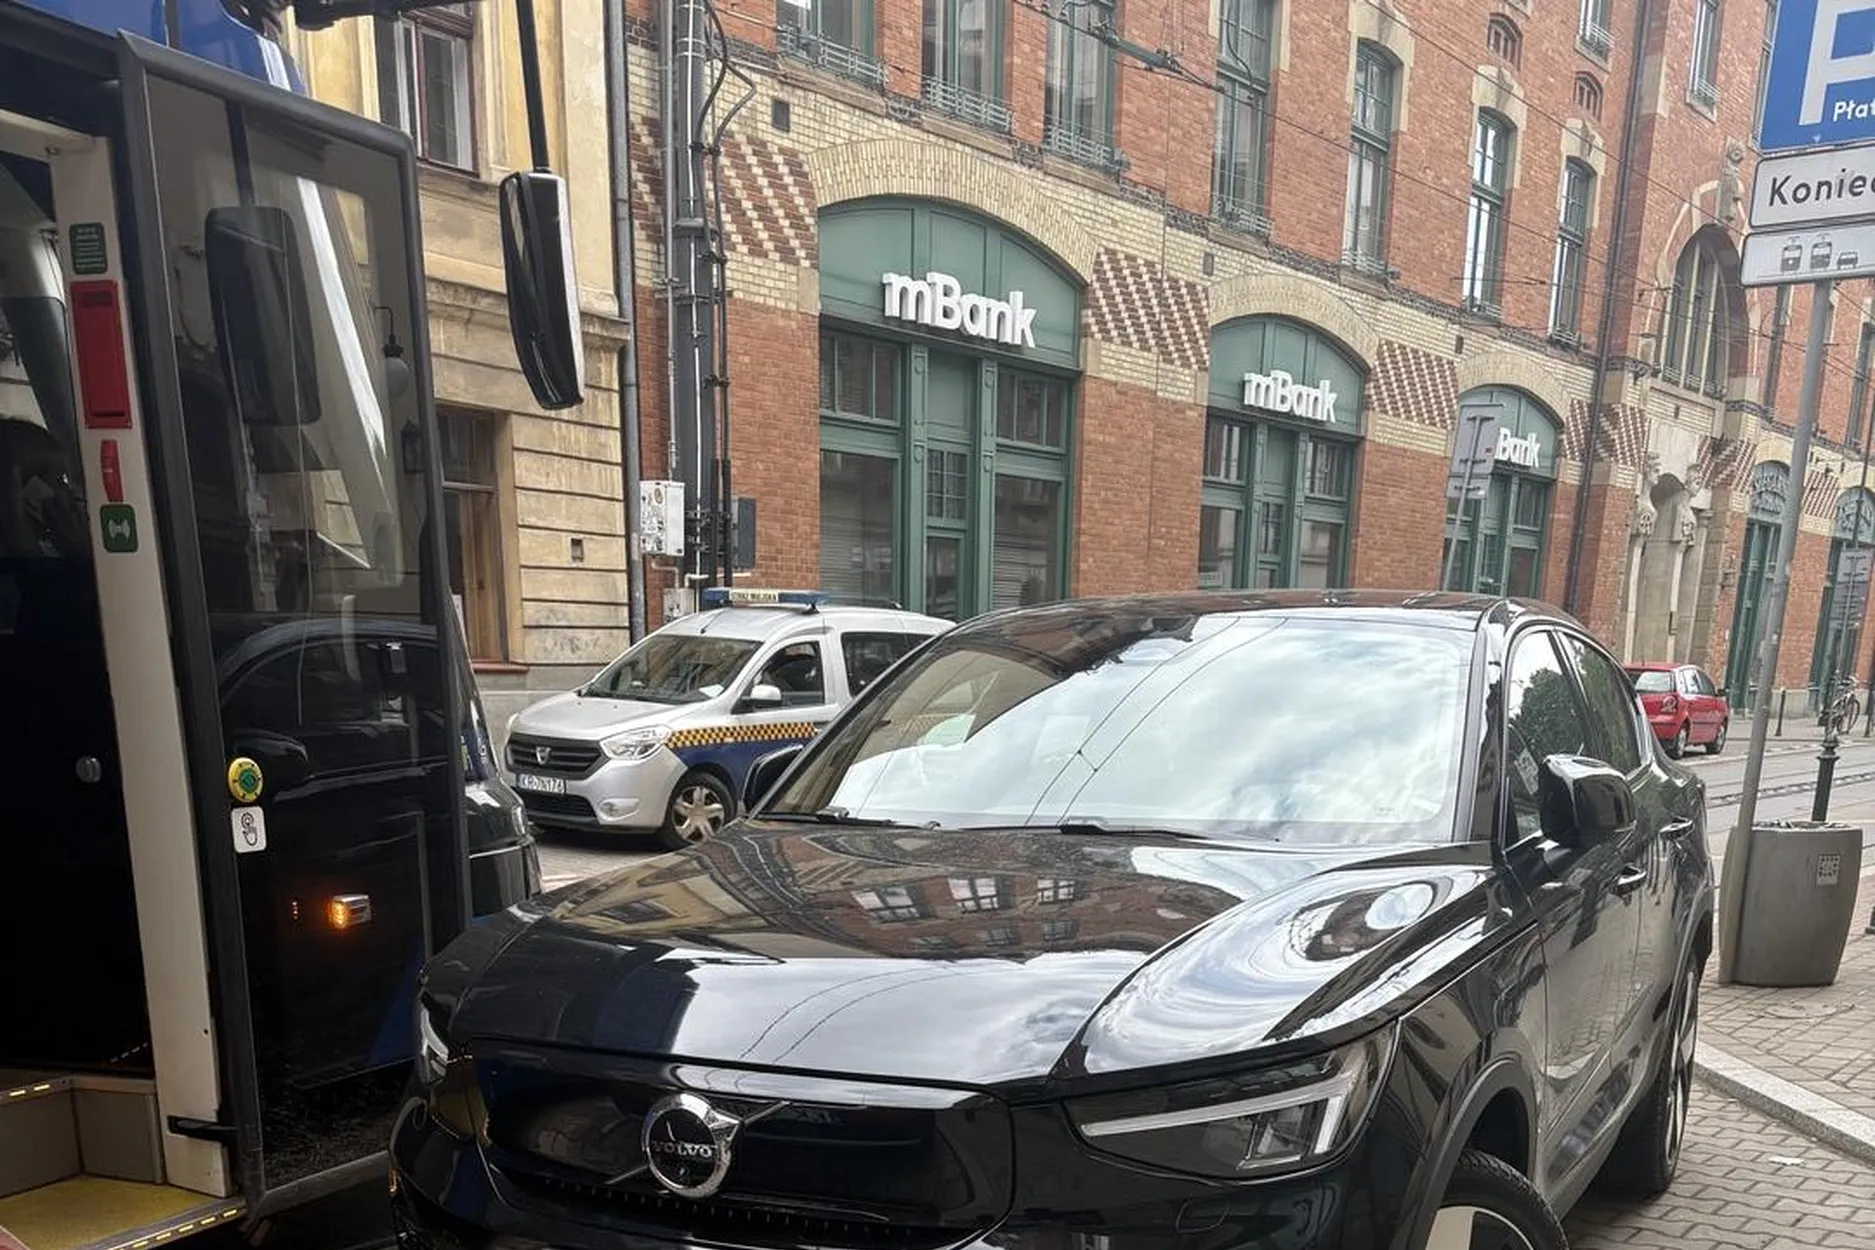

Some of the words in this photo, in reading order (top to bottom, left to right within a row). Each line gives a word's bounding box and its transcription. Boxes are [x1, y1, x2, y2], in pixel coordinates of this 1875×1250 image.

[882, 272, 1037, 348] mBank
[1243, 370, 1338, 423] mBank
[1494, 427, 1541, 468] Bank
[651, 1141, 712, 1158] VOLVO
